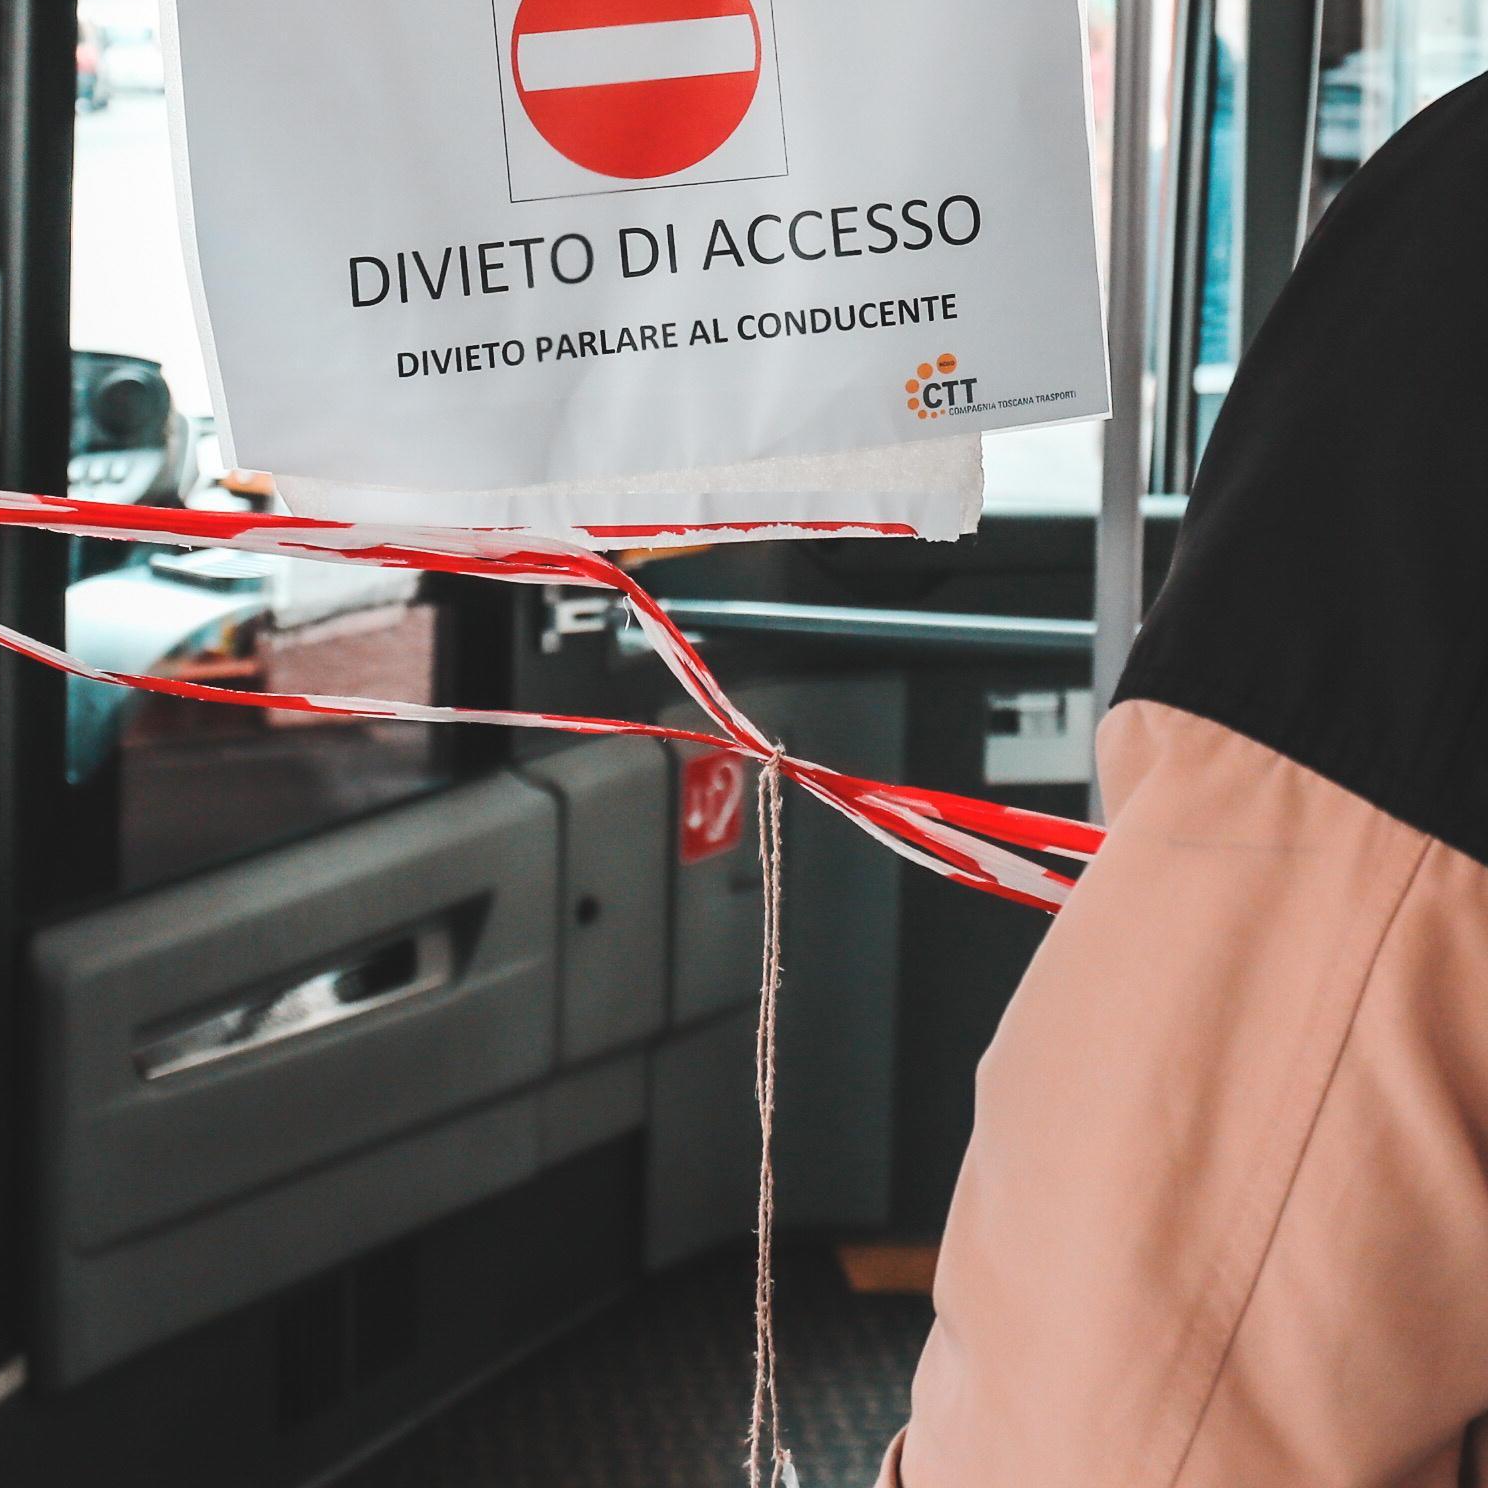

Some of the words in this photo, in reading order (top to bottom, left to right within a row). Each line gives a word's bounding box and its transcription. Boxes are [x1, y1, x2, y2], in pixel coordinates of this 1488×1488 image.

[349, 232, 595, 309] DIVIETO
[619, 223, 679, 279] DI
[703, 194, 982, 271] ACCESSO
[396, 340, 526, 379] DIVIETO
[536, 321, 679, 363] PARLARE
[689, 315, 728, 346] AL
[736, 293, 959, 342] CONDUCENTE
[922, 378, 978, 409] CTT
[949, 402, 997, 416] COMPAGNIA
[998, 396, 1034, 409] TOSCANA
[1036, 390, 1077, 404] TRASPORTI
